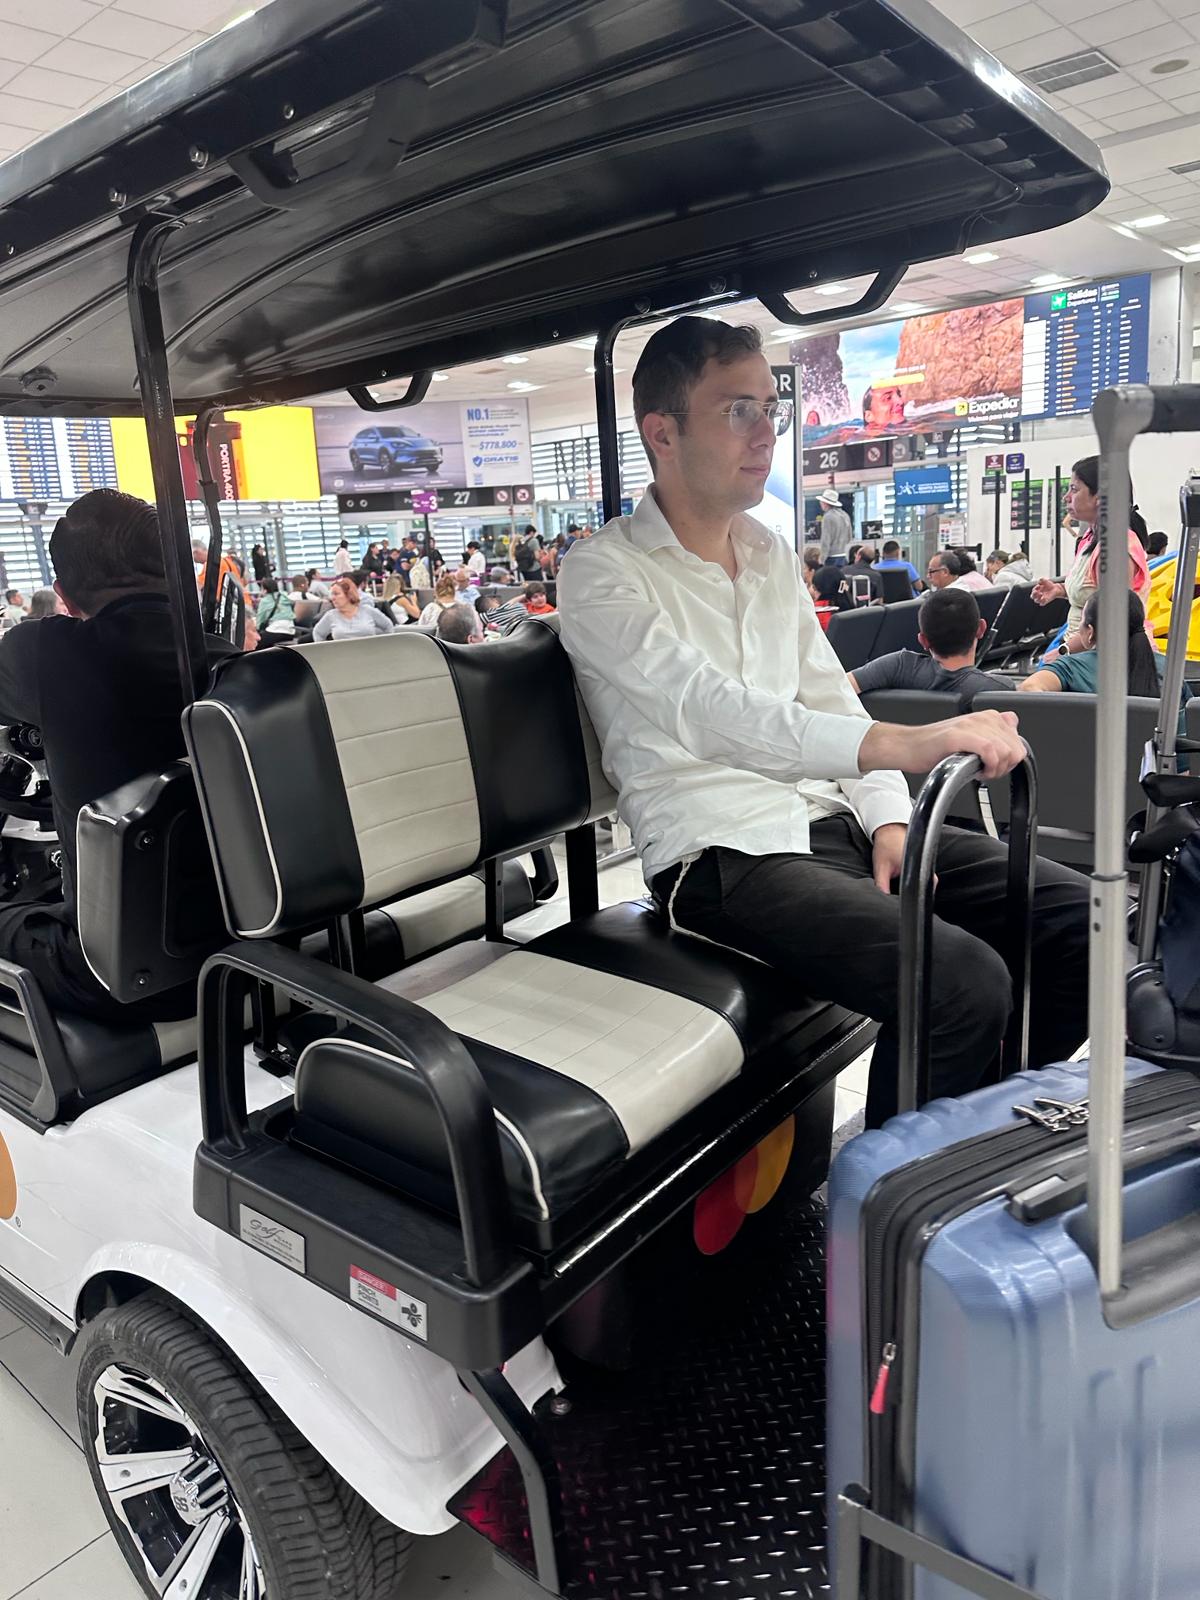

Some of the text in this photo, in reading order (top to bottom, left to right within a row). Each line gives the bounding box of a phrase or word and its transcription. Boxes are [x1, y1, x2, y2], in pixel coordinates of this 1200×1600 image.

[1067, 289, 1098, 301] Salidas
[969, 397, 1020, 415] Expedia
[467, 408, 489, 421] NO.1
[484, 455, 519, 463] GRATIS
[820, 451, 839, 469] 26
[219, 443, 235, 500] PORTRA 400
[429, 495, 438, 510] 3
[454, 491, 471, 505] 27
[1099, 495, 1109, 574] RICARDO
[249, 1218, 286, 1239] Golf
